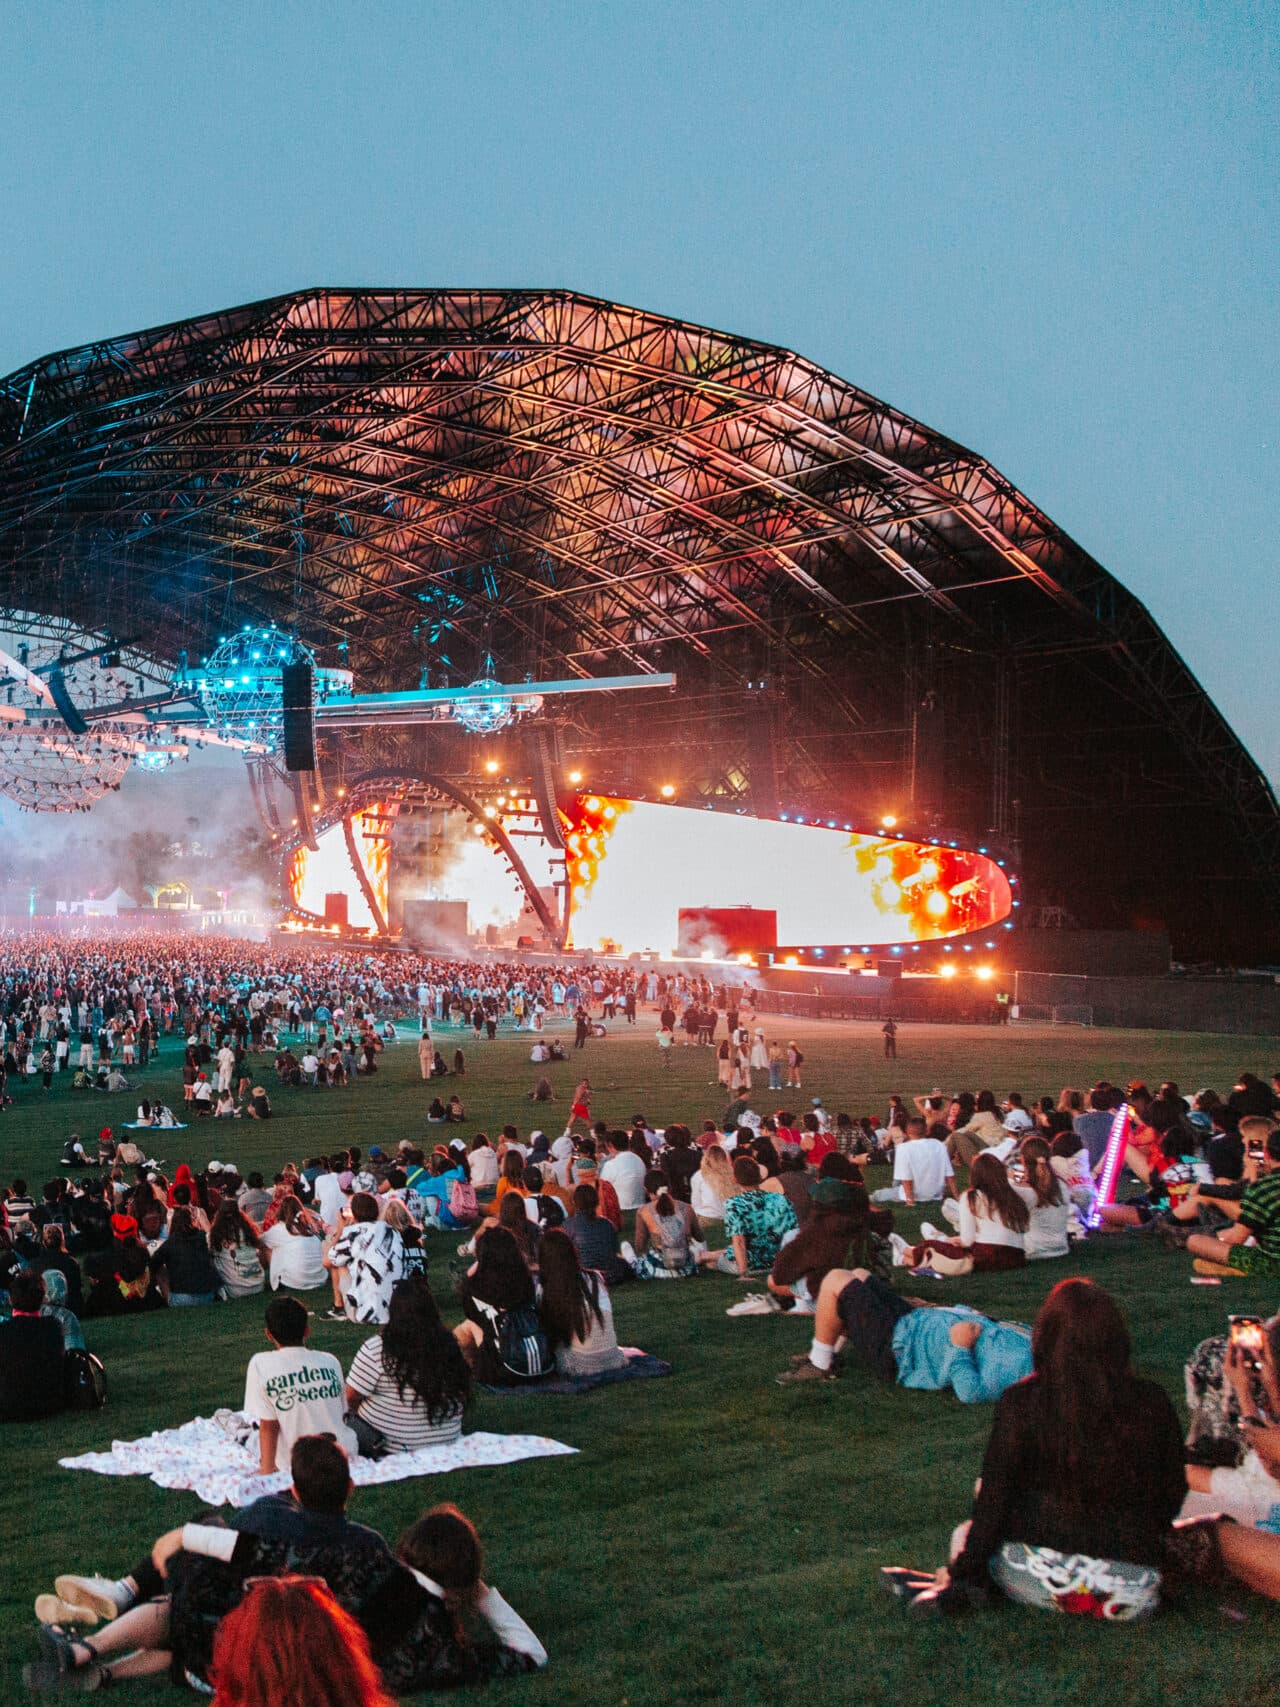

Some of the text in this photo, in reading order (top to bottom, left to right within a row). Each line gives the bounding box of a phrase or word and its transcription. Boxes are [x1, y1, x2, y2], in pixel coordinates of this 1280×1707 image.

[266, 1365, 338, 1397] gardens
[275, 1382, 342, 1411] & seeds
